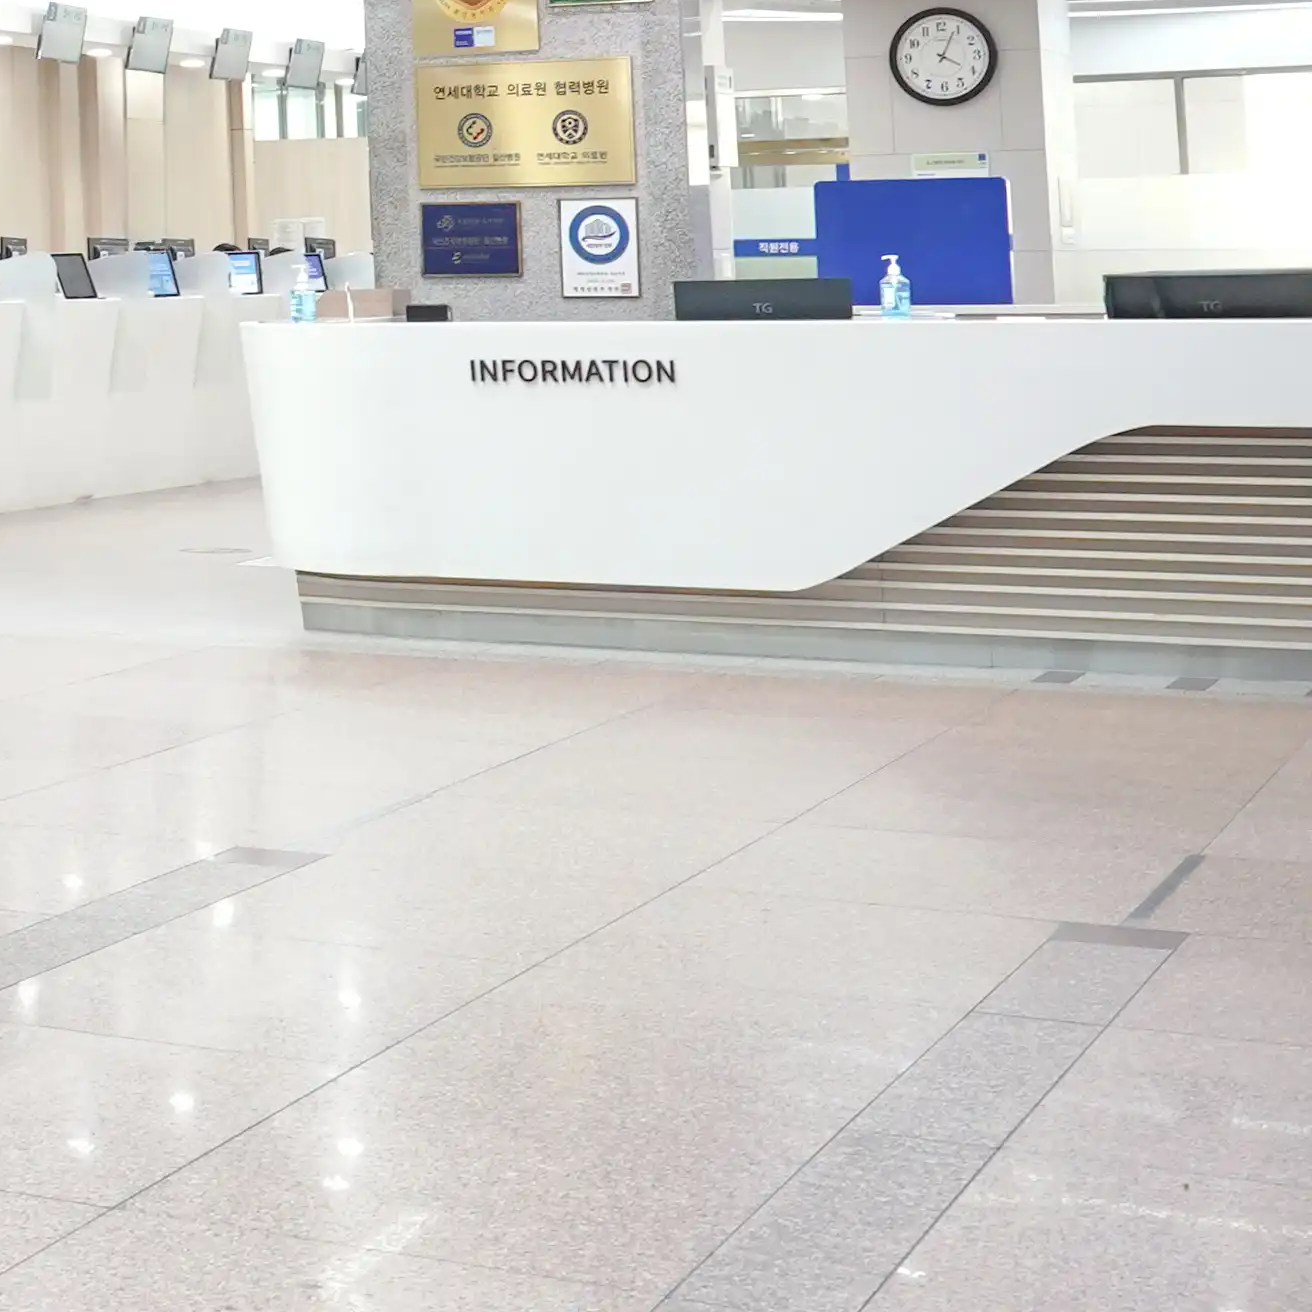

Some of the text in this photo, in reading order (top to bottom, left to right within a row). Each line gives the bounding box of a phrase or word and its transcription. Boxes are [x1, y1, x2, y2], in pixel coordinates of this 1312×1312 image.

[936, 21, 946, 32] 12
[909, 38, 920, 49] 10
[966, 35, 975, 46] 2
[904, 53, 912, 64] 9
[973, 49, 982, 60] 3
[911, 69, 919, 79] 8
[940, 81, 949, 92] 6
[956, 78, 965, 88] 5
[433, 78, 610, 100] 연세대학교 의료원 협력병원
[536, 151, 579, 161] 연세대학교
[758, 241, 799, 254] 직원전용
[752, 302, 773, 314] TG
[470, 359, 676, 384] INFORMATION
